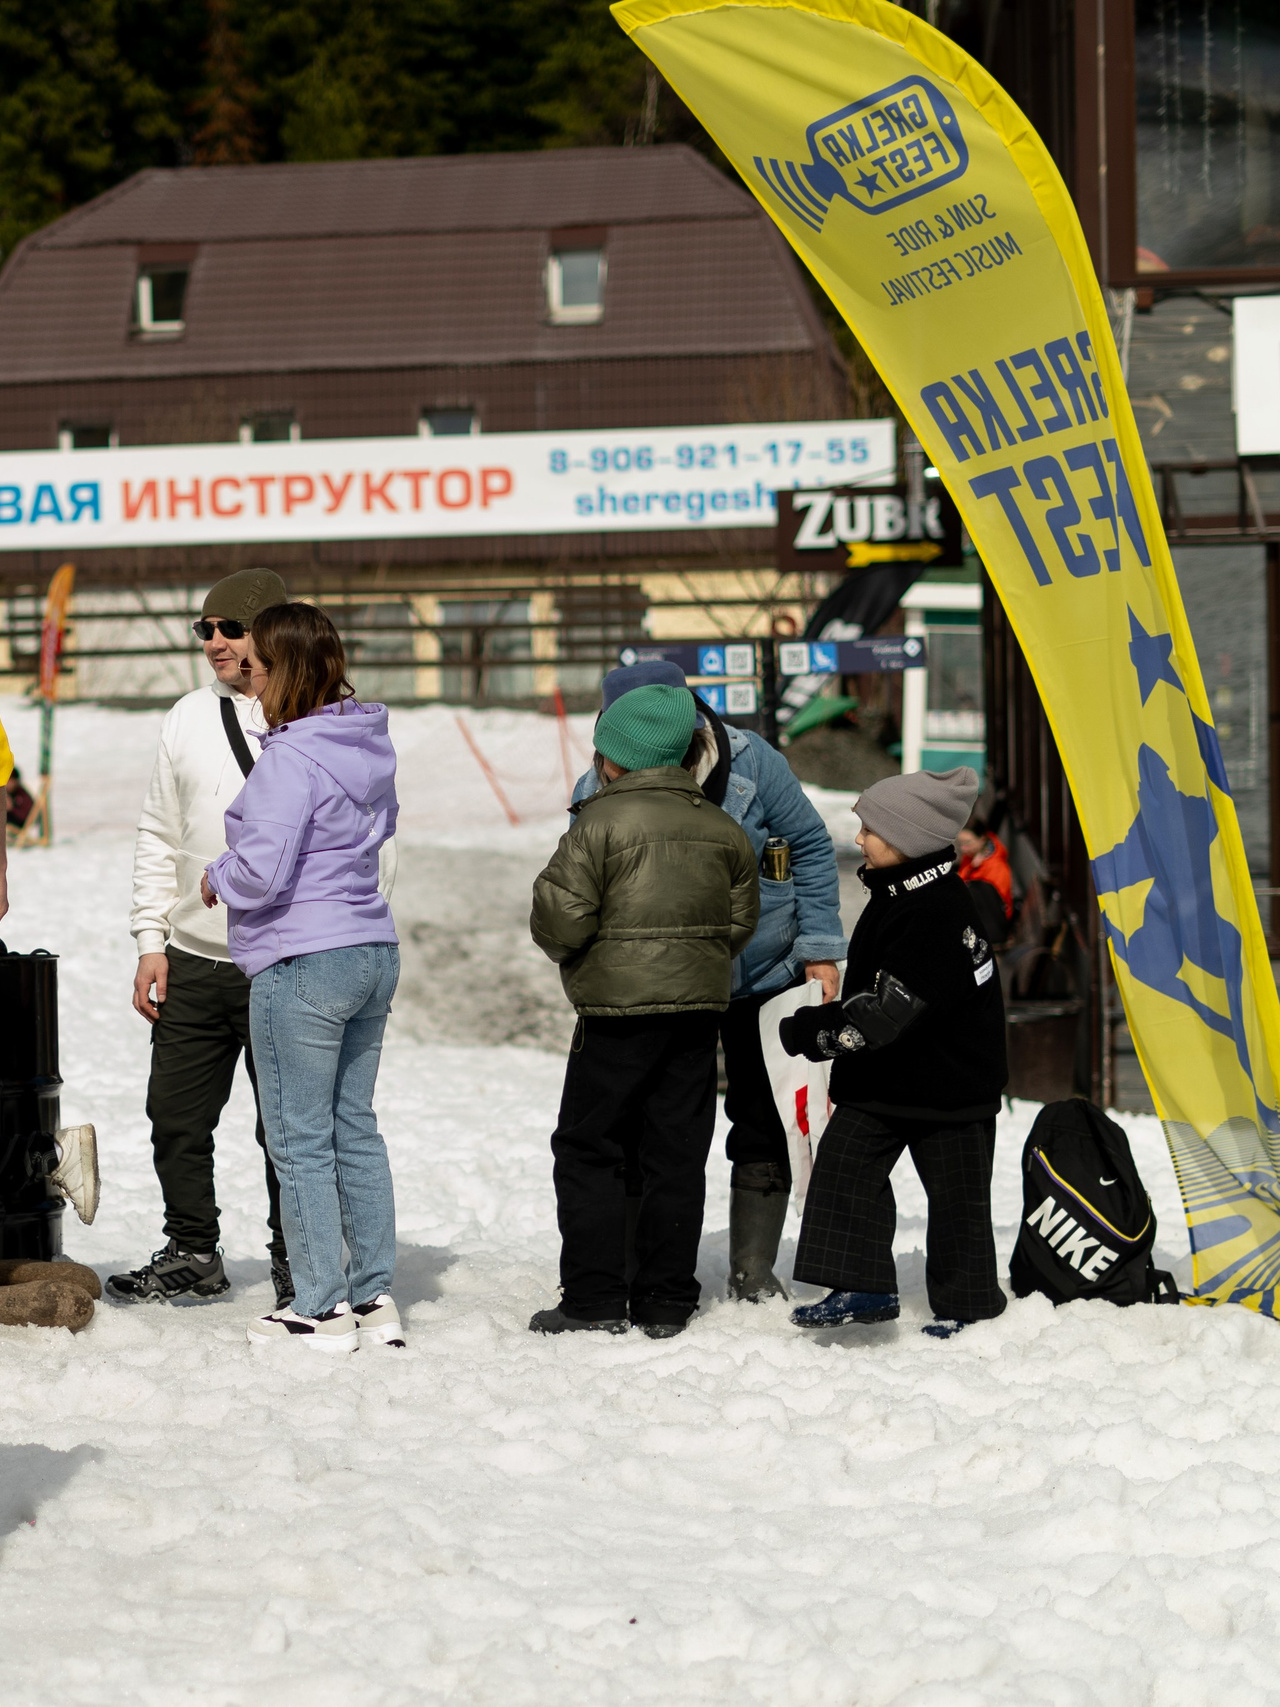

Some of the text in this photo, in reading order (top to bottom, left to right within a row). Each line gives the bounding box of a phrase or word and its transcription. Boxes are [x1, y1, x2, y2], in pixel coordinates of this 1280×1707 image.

[549, 438, 870, 475] 8-906-921-17-55
[121, 466, 513, 520] ИНСТРУКТОР
[1026, 1195, 1120, 1282] NIKE
